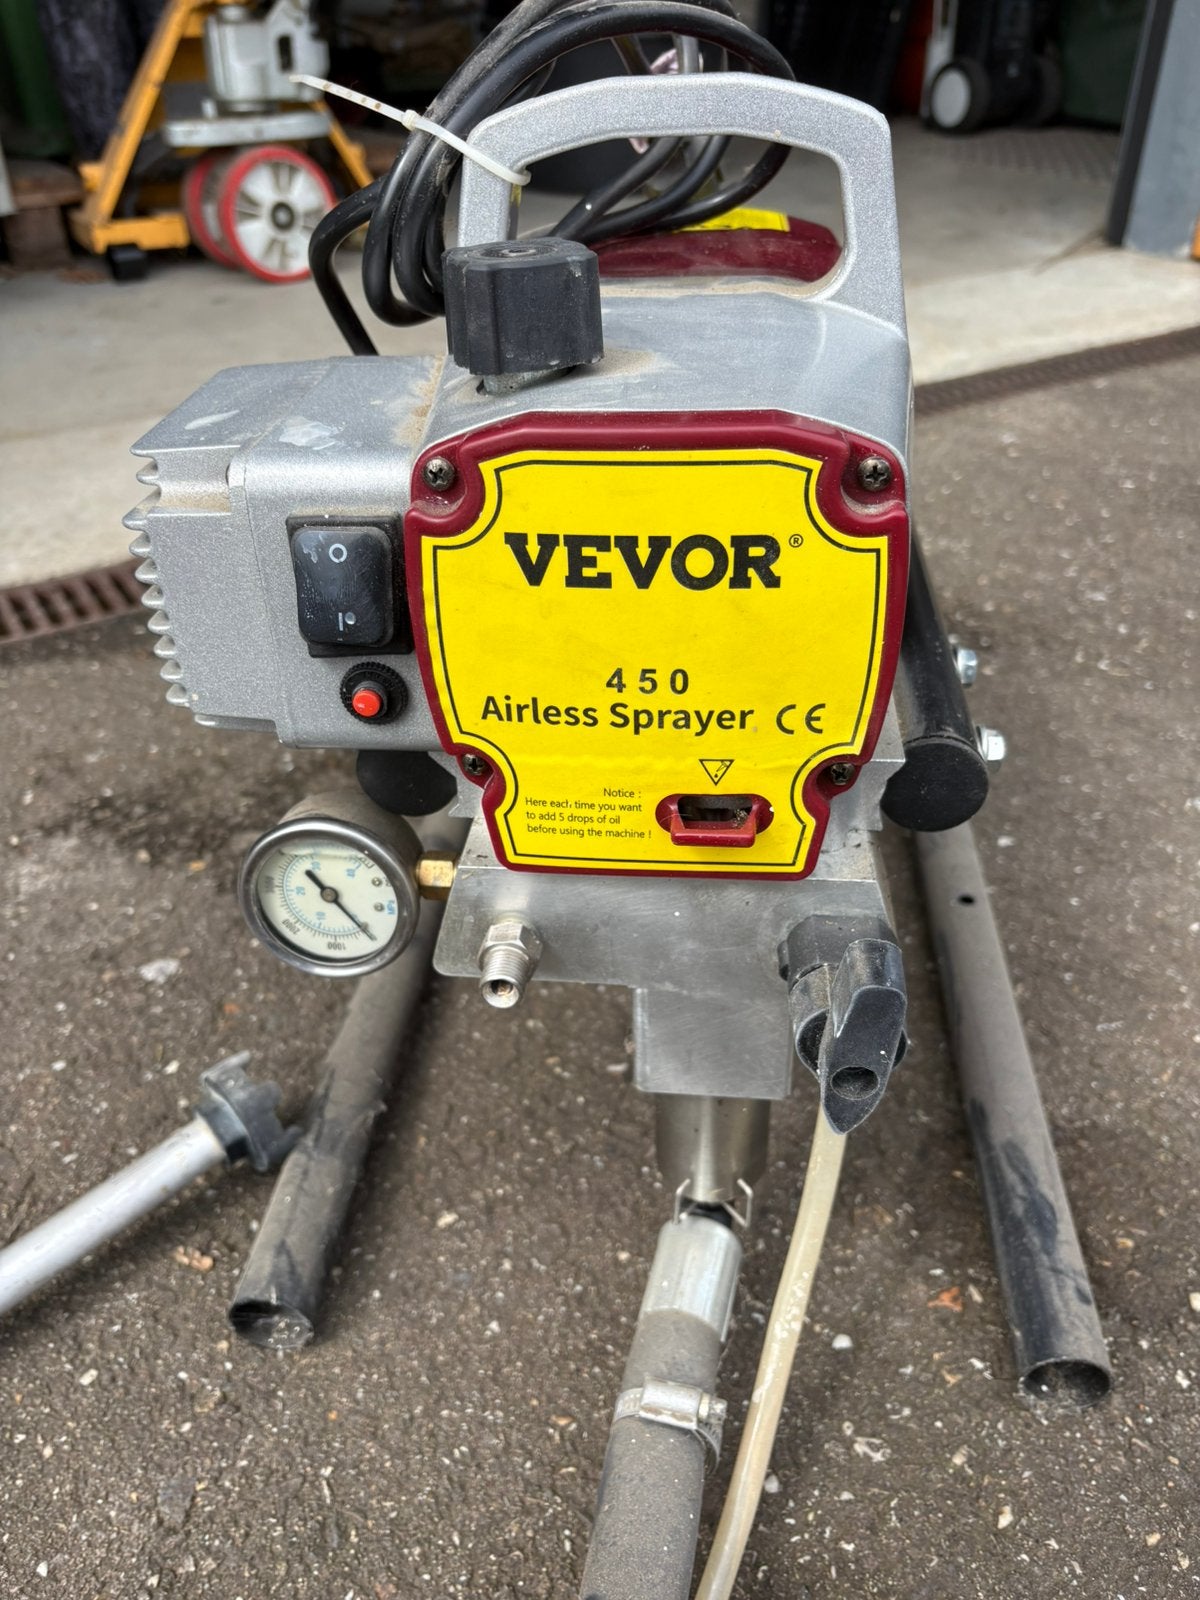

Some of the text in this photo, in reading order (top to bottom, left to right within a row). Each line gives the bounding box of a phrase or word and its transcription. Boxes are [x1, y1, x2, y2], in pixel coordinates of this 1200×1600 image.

[481, 695, 754, 737] Airless Sprayer
[525, 797, 548, 807] Here
[574, 800, 596, 810] time
[598, 803, 616, 812] you
[619, 804, 642, 812] want
[526, 811, 621, 825] to add 5 drops of oil
[527, 824, 557, 834] before
[559, 827, 585, 838] using
[587, 828, 602, 837] the
[605, 829, 645, 839] machine
[327, 942, 346, 950] 1000
